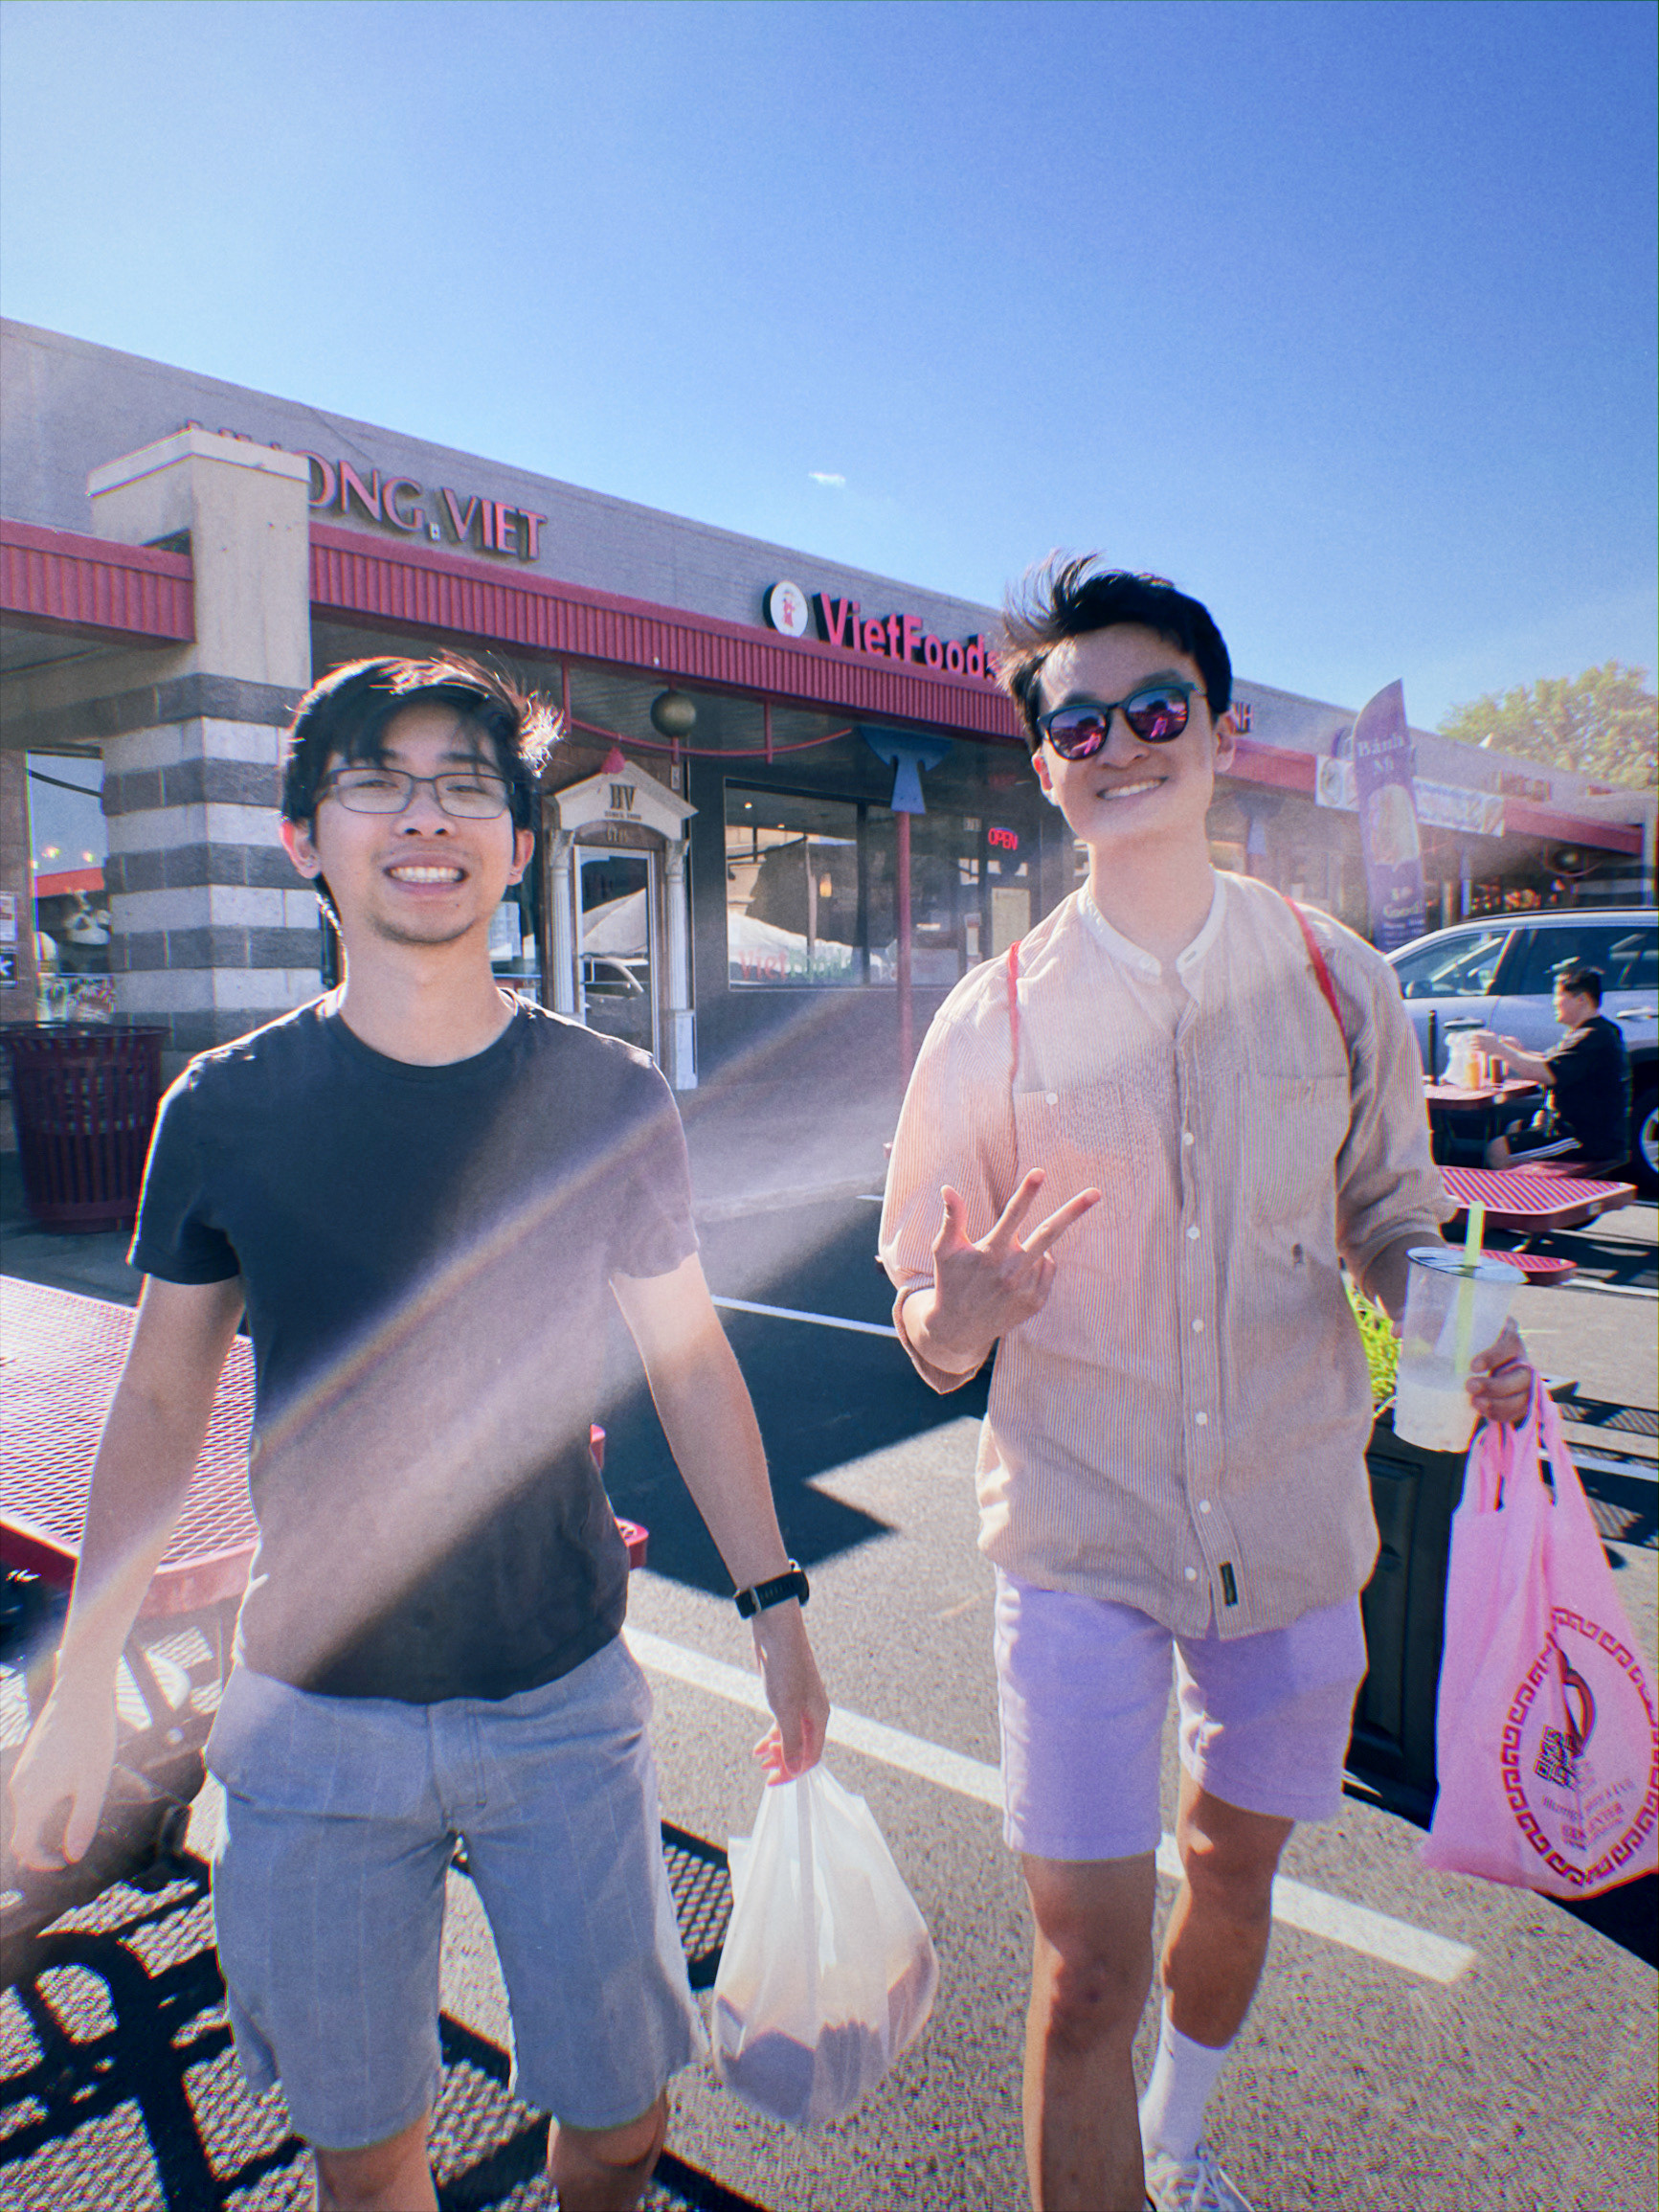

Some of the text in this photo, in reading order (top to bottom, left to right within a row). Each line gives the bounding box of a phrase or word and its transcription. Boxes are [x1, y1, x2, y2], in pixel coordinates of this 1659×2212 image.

[441, 486, 548, 560] VIET
[609, 782, 638, 812] HV
[988, 827, 1019, 850] OPEN
